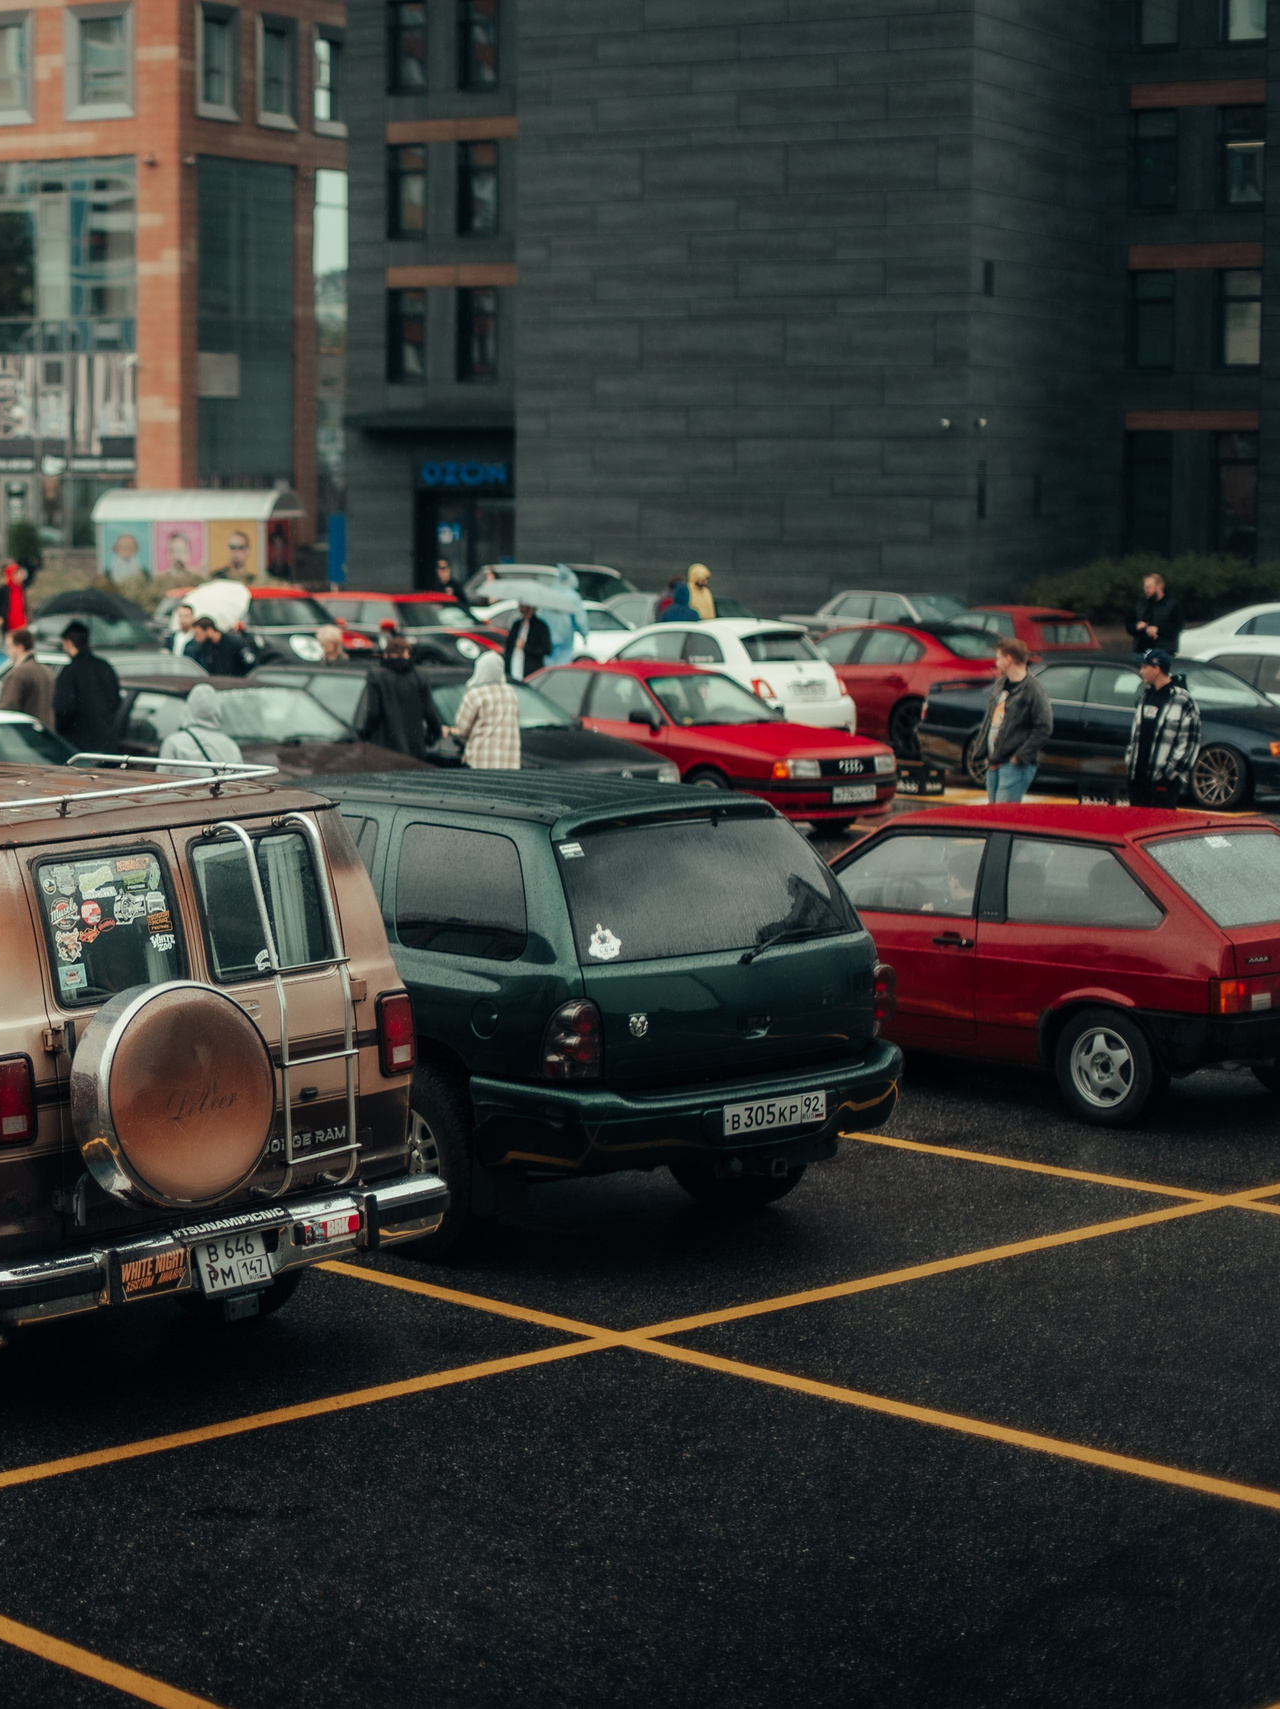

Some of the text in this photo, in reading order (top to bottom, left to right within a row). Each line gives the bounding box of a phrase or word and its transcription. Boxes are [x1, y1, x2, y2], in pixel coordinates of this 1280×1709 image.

[421, 461, 508, 486] OZON
[150, 933, 176, 949] WHITE
[803, 1095, 820, 1113] 92
[314, 1125, 347, 1144] RAM
[172, 1207, 285, 1238] #TSUNAMIPICNIC
[121, 1248, 186, 1283] WHITE NIGHT
[241, 1258, 264, 1276] 147
